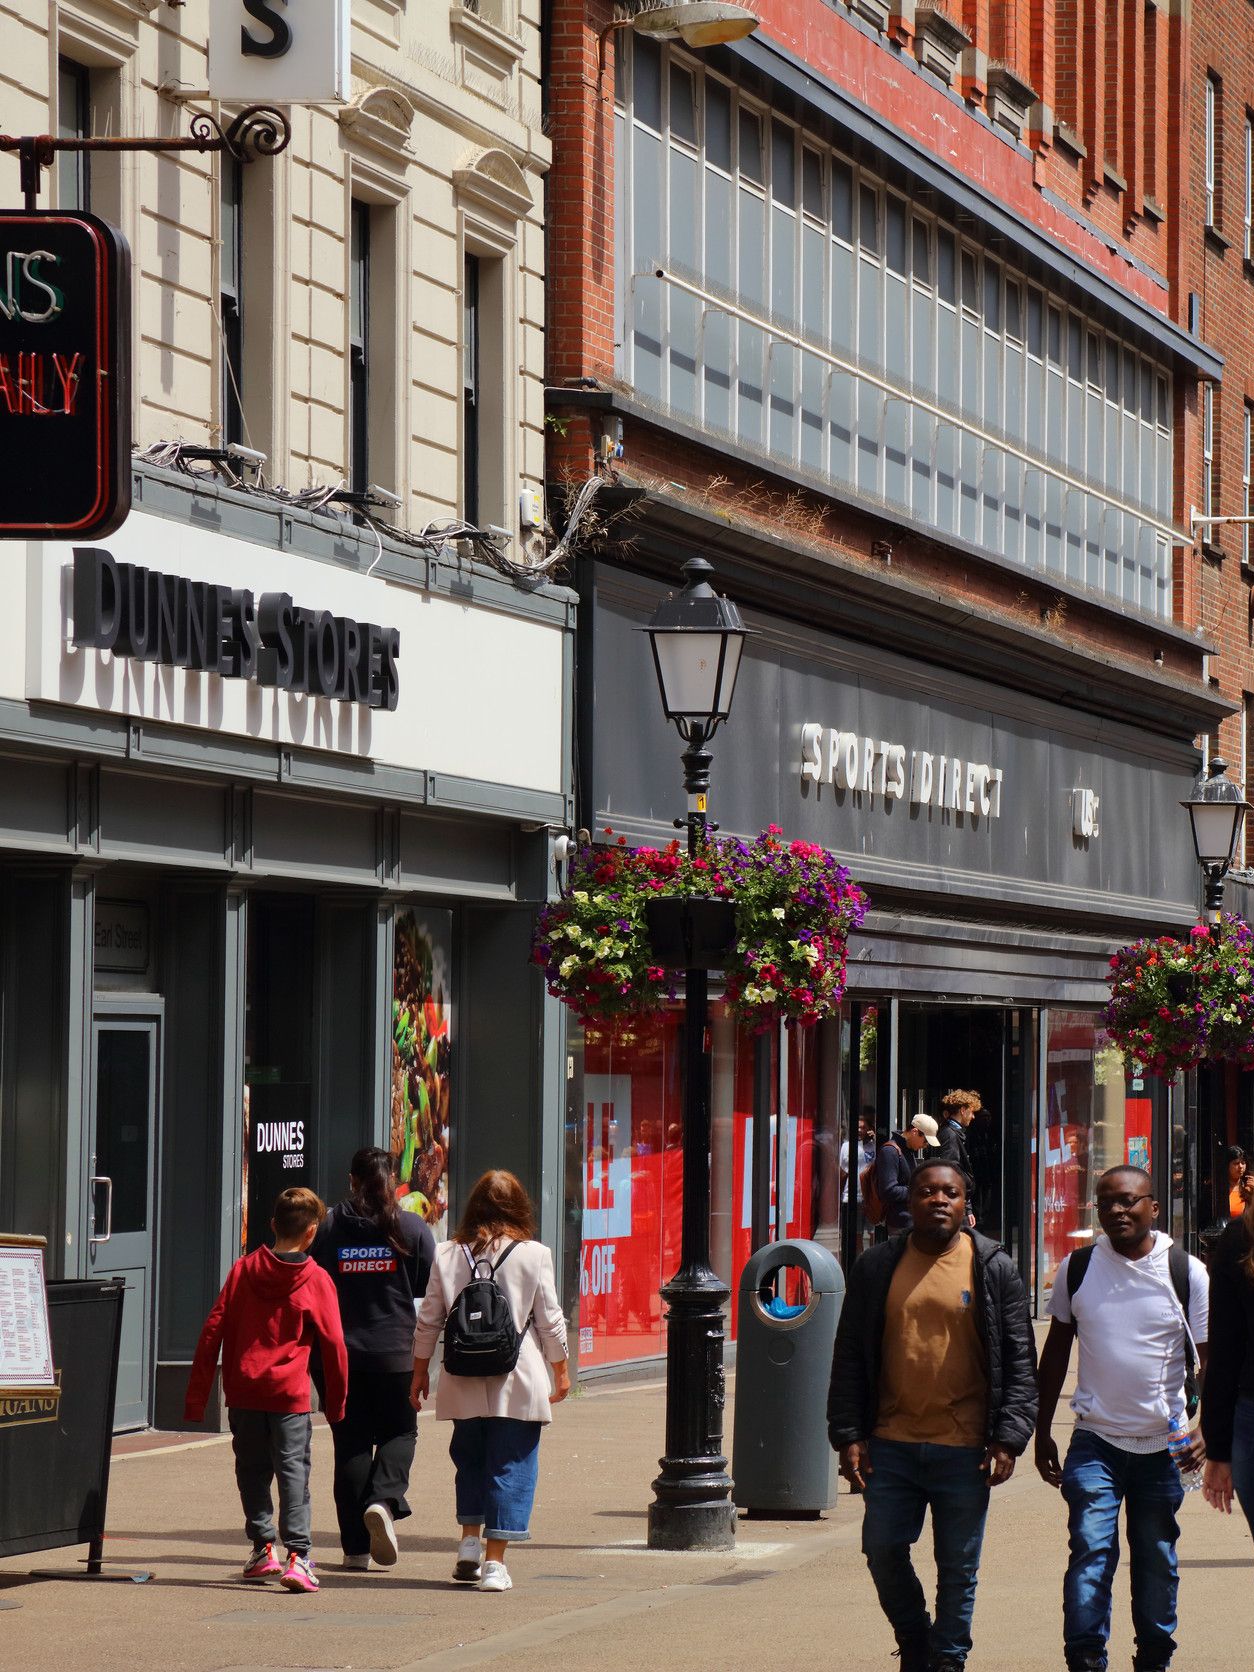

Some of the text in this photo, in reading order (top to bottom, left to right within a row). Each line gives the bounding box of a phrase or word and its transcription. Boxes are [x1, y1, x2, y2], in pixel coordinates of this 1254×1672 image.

[72, 546, 401, 712] DUNNES STORES
[801, 722, 1003, 818] SPORTS DIRECT
[256, 1120, 304, 1153] DUNNES
[282, 1153, 304, 1169] STORES
[341, 1247, 392, 1259] SPORTS
[342, 1260, 393, 1272] DIRECT
[591, 1243, 615, 1296] OFF
